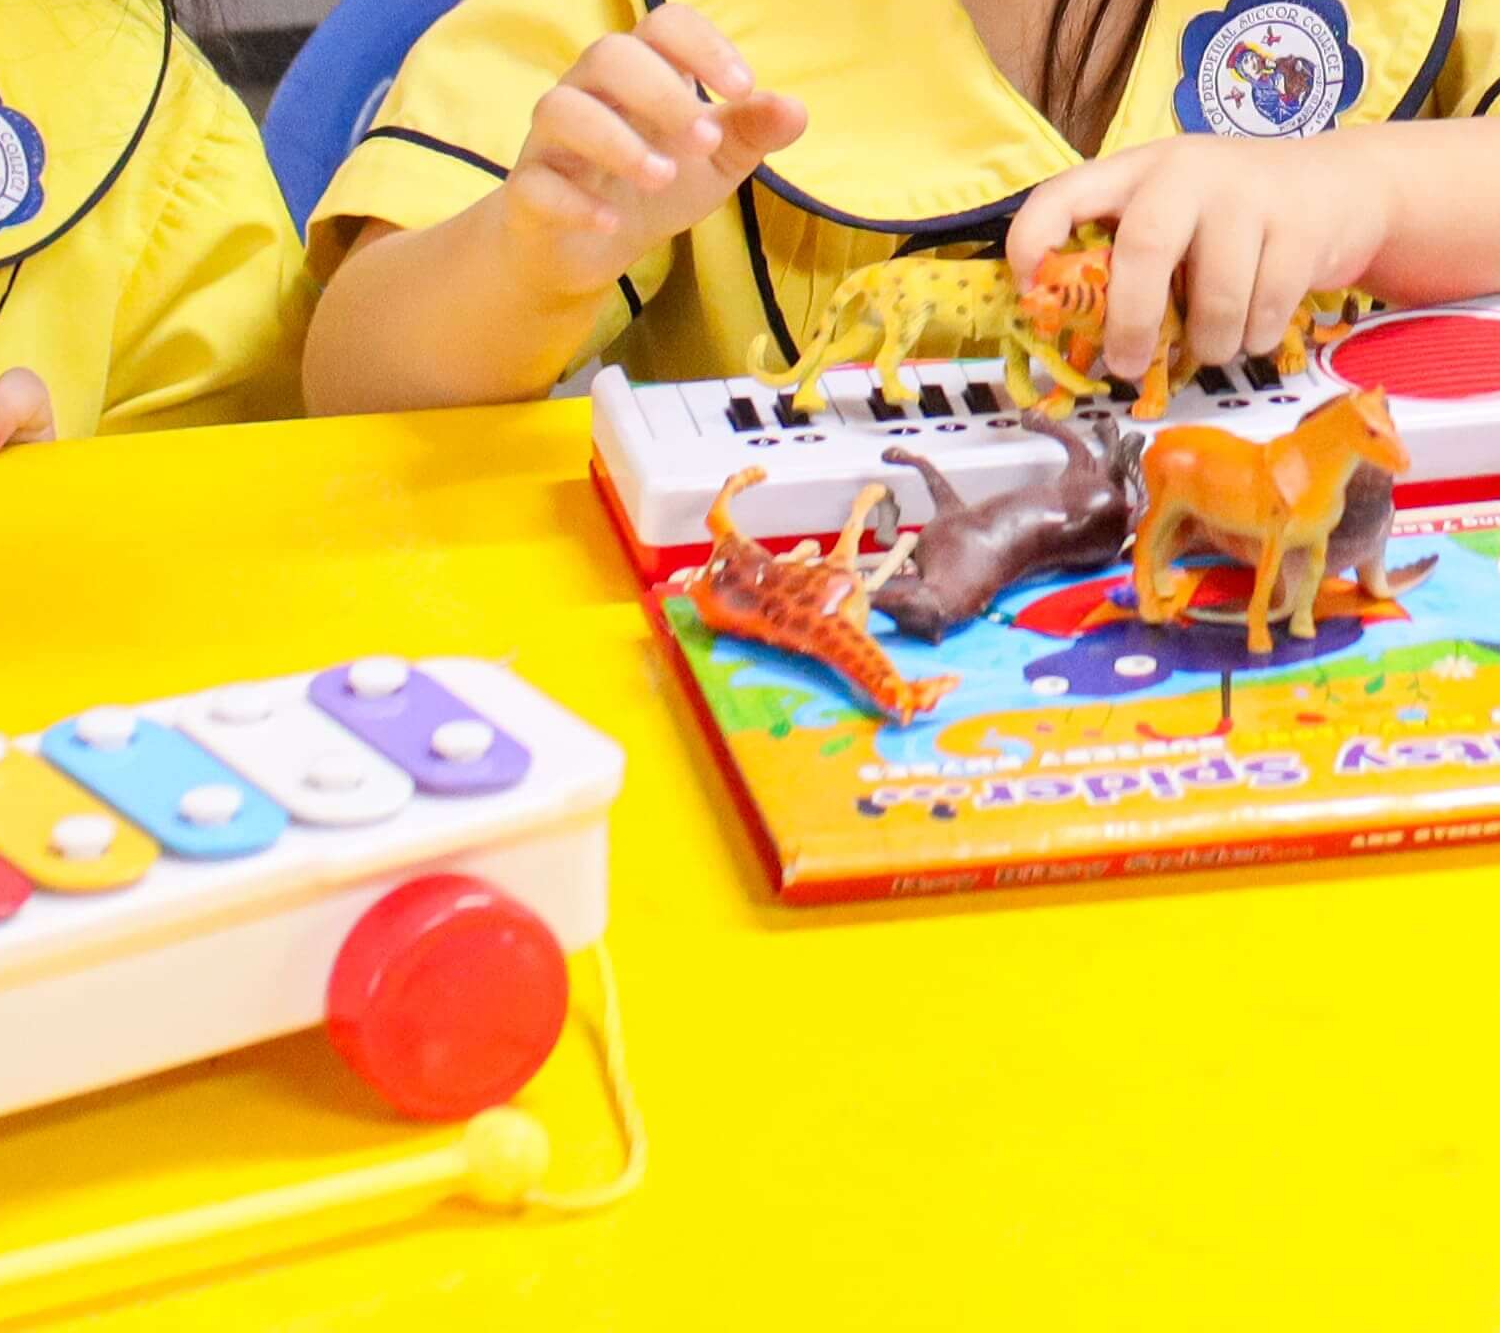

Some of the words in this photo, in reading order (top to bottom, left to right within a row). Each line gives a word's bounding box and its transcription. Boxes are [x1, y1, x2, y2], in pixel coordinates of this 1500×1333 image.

[1202, 29, 1237, 102] PERPETUAL
[1239, 6, 1299, 29] SUCCOR
[1302, 15, 1340, 73] COLLEGE
[1038, 735, 1228, 768] NURSERY
[1349, 830, 1404, 850] AND
